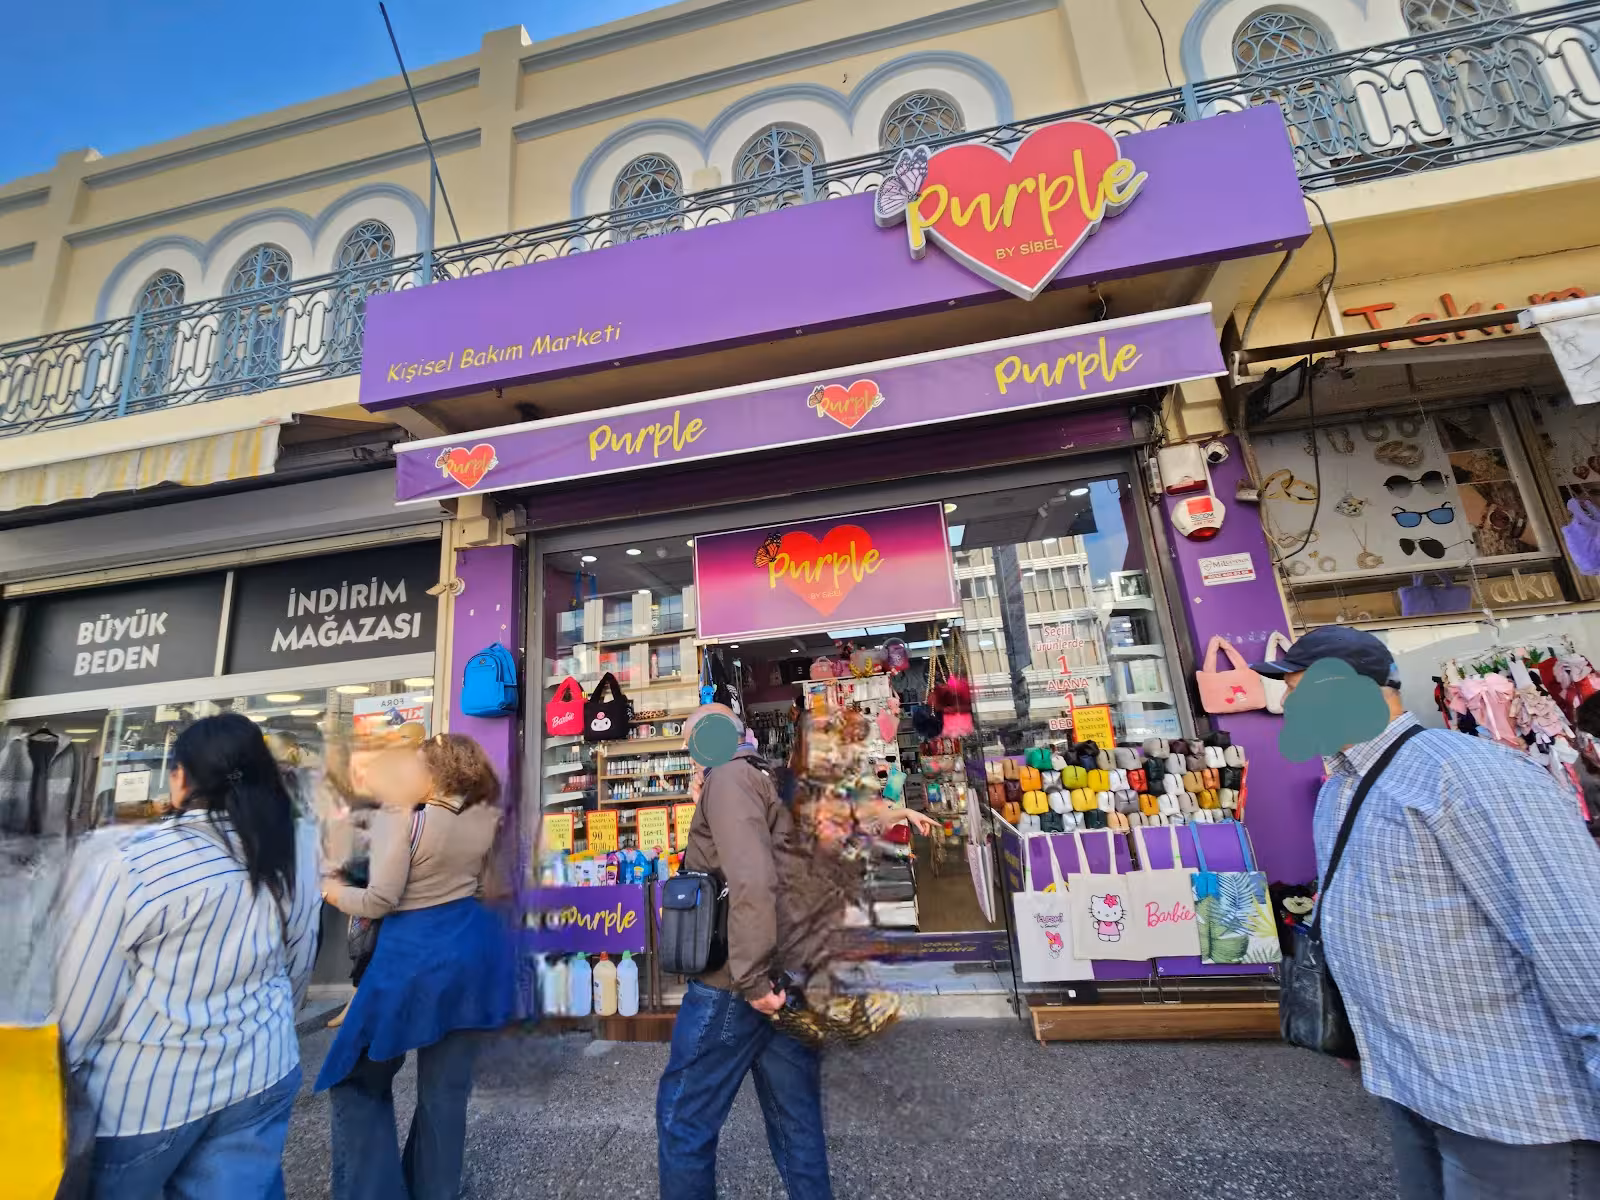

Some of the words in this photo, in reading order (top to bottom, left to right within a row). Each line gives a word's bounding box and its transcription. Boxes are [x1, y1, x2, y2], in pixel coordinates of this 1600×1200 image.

[995, 246, 1016, 260] BY
[1019, 238, 1063, 255] SİBEL
[387, 357, 452, 383] Kişisel
[460, 336, 523, 368] Bakım
[531, 321, 622, 355] Marketi
[286, 577, 407, 619] İNDİRİM
[76, 610, 167, 647] BÜYÜK
[271, 611, 421, 653] MAĞAZASI
[1044, 624, 1071, 638] Seçili
[73, 643, 160, 676] BEDEN
[1057, 655, 1072, 675] 1
[1048, 678, 1089, 691] ALANA
[552, 711, 575, 729] Barbie
[1050, 719, 1074, 730] BED
[1145, 901, 1197, 928] Barbie
